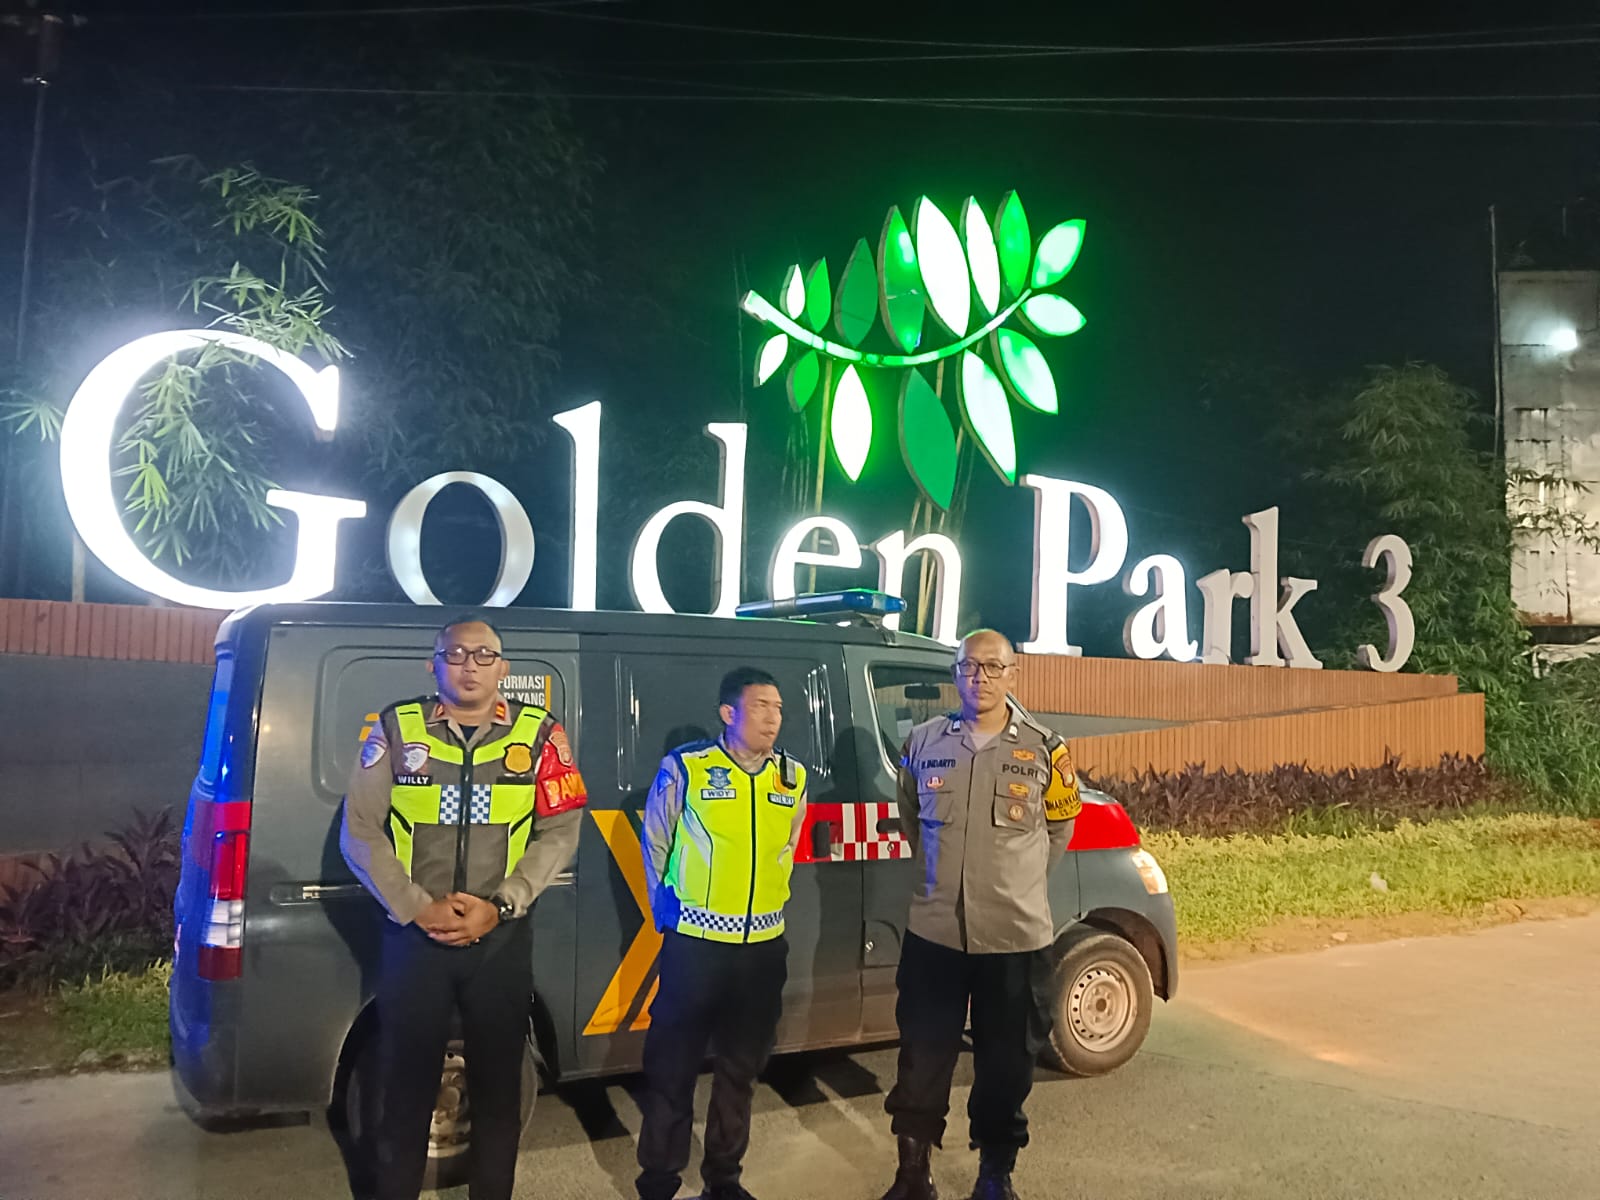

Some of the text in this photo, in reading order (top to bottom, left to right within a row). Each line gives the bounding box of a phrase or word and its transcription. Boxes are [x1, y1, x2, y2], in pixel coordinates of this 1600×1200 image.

[60, 328, 1414, 672] Golden Park 3
[517, 692, 545, 706] YANG
[1002, 763, 1038, 779] POLRI
[398, 776, 429, 785] WILLY
